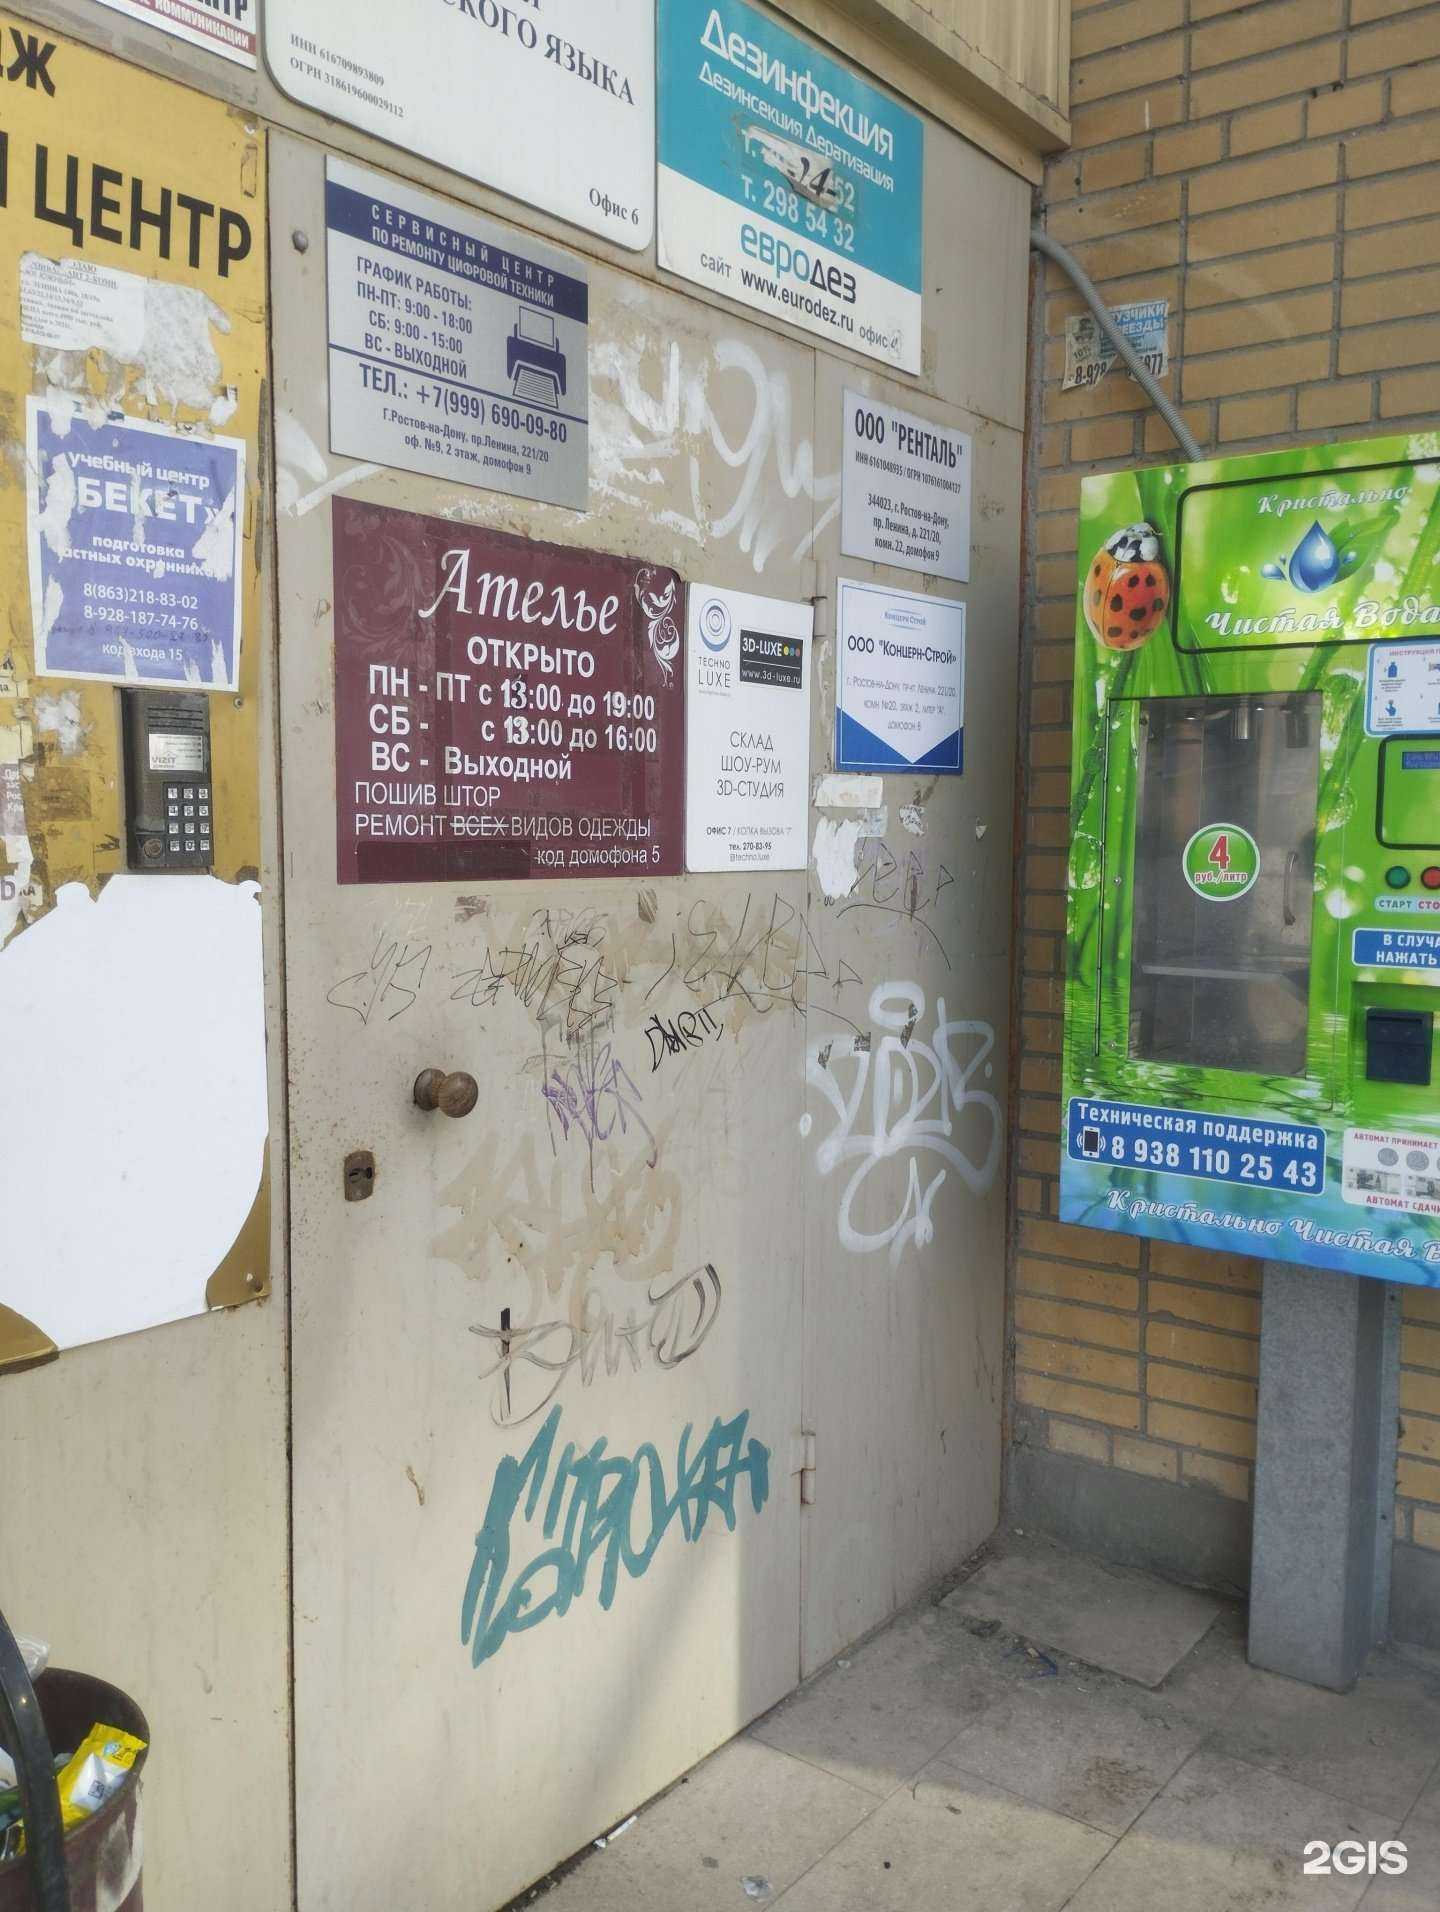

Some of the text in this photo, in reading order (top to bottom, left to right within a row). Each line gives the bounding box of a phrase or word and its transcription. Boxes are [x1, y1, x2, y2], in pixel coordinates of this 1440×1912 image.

[0, 27, 57, 98] Ж
[291, 33, 385, 87] ИНН 616709893809
[443, 0, 634, 105] КОГО ЯЗЫКА
[290, 56, 405, 118] ОГРН 318619600029112
[700, 9, 894, 160] Дезинфекция
[698, 62, 803, 139] Дезинсекция
[805, 125, 895, 193] Дератизация
[34, 143, 251, 278] ЦЕНТР
[589, 188, 640, 225] Офис 6
[763, 179, 799, 224] 298
[805, 205, 828, 239] 54
[834, 218, 856, 253] 32
[371, 204, 555, 288] СЕРВИСНЫЙ ЦЕНТР
[372, 226, 555, 308] ПО РЕМОНТУ ЦИФРОВОЙ ТЕХНИКИ
[357, 256, 473, 312] ГРАФИК РАБОТЫ:
[700, 251, 888, 348] сайт www.eurodez.ru офис
[357, 281, 473, 334] ПН-ПТ: 9:00 18:00
[369, 310, 463, 354] СБ: 9:00 15:00
[365, 333, 467, 379] ВС ВЫХОДНОЙ
[359, 362, 567, 443] ТЕЛ.: +7(999) 690-09-80
[522, 445, 549, 463] 221/20
[855, 408, 963, 469] ООО "РЕНТАЛЬ"
[69, 451, 210, 490] учебный центр
[446, 444, 452, 456] 2
[483, 454, 524, 475] домофон
[525, 464, 531, 475] 9
[856, 450, 868, 465] ИНН
[906, 468, 921, 482] ОГРН
[868, 493, 894, 513] 344023,
[1256, 486, 1409, 518] Кристально
[873, 517, 884, 531] пр.
[60, 547, 122, 566] астных
[93, 536, 185, 559] подготовка
[906, 545, 935, 561] домофон
[935, 550, 940, 561] 9
[83, 583, 199, 610] 8(863)218-83-02
[418, 549, 619, 636] Ателье
[83, 605, 199, 631] 8-928-187-74-76
[1205, 597, 1440, 636] Чистая Вода
[169, 649, 183, 660] 15
[467, 636, 595, 678] ОТКРЫТО
[742, 637, 783, 657] 3D-LUXE
[848, 635, 875, 653] ООО
[698, 656, 731, 670] TECHNO
[698, 669, 731, 688] LUXE
[741, 669, 800, 684] www.3d-luxe.ru
[369, 664, 656, 721] ПН ПТ с 13:00 до 19:00
[369, 704, 657, 753] СБ с 13:00 до 16:00
[729, 731, 774, 752] СКЛАД
[371, 741, 573, 783] ВС Выходной
[720, 756, 782, 774] ШОУ-РУМ
[355, 781, 501, 808] ПОШИВ ШТОР
[716, 779, 784, 798] 3D-СТУДИЯ
[355, 813, 651, 840] РЕМОНТ ВСЕХ ВИДОВ ОДЕЖДЫ
[706, 826, 726, 836] ОФИС
[537, 846, 660, 867] код домофона 5
[1208, 833, 1231, 870] 4
[1194, 871, 1248, 885] руб./литр
[1379, 899, 1412, 909] СТАРТ
[1384, 934, 1392, 945] В
[1376, 951, 1437, 965] НАЖАТЬ
[1078, 1102, 1319, 1151] Техническая поддержка
[1354, 1132, 1438, 1149] АВТОМАТ ПРИНИМАЕТ
[1111, 1136, 1317, 1188] 8 938 110 25 43
[1366, 1194, 1410, 1209] АВТОМАТ
[1107, 1189, 1416, 1258] Кристально Чистая
